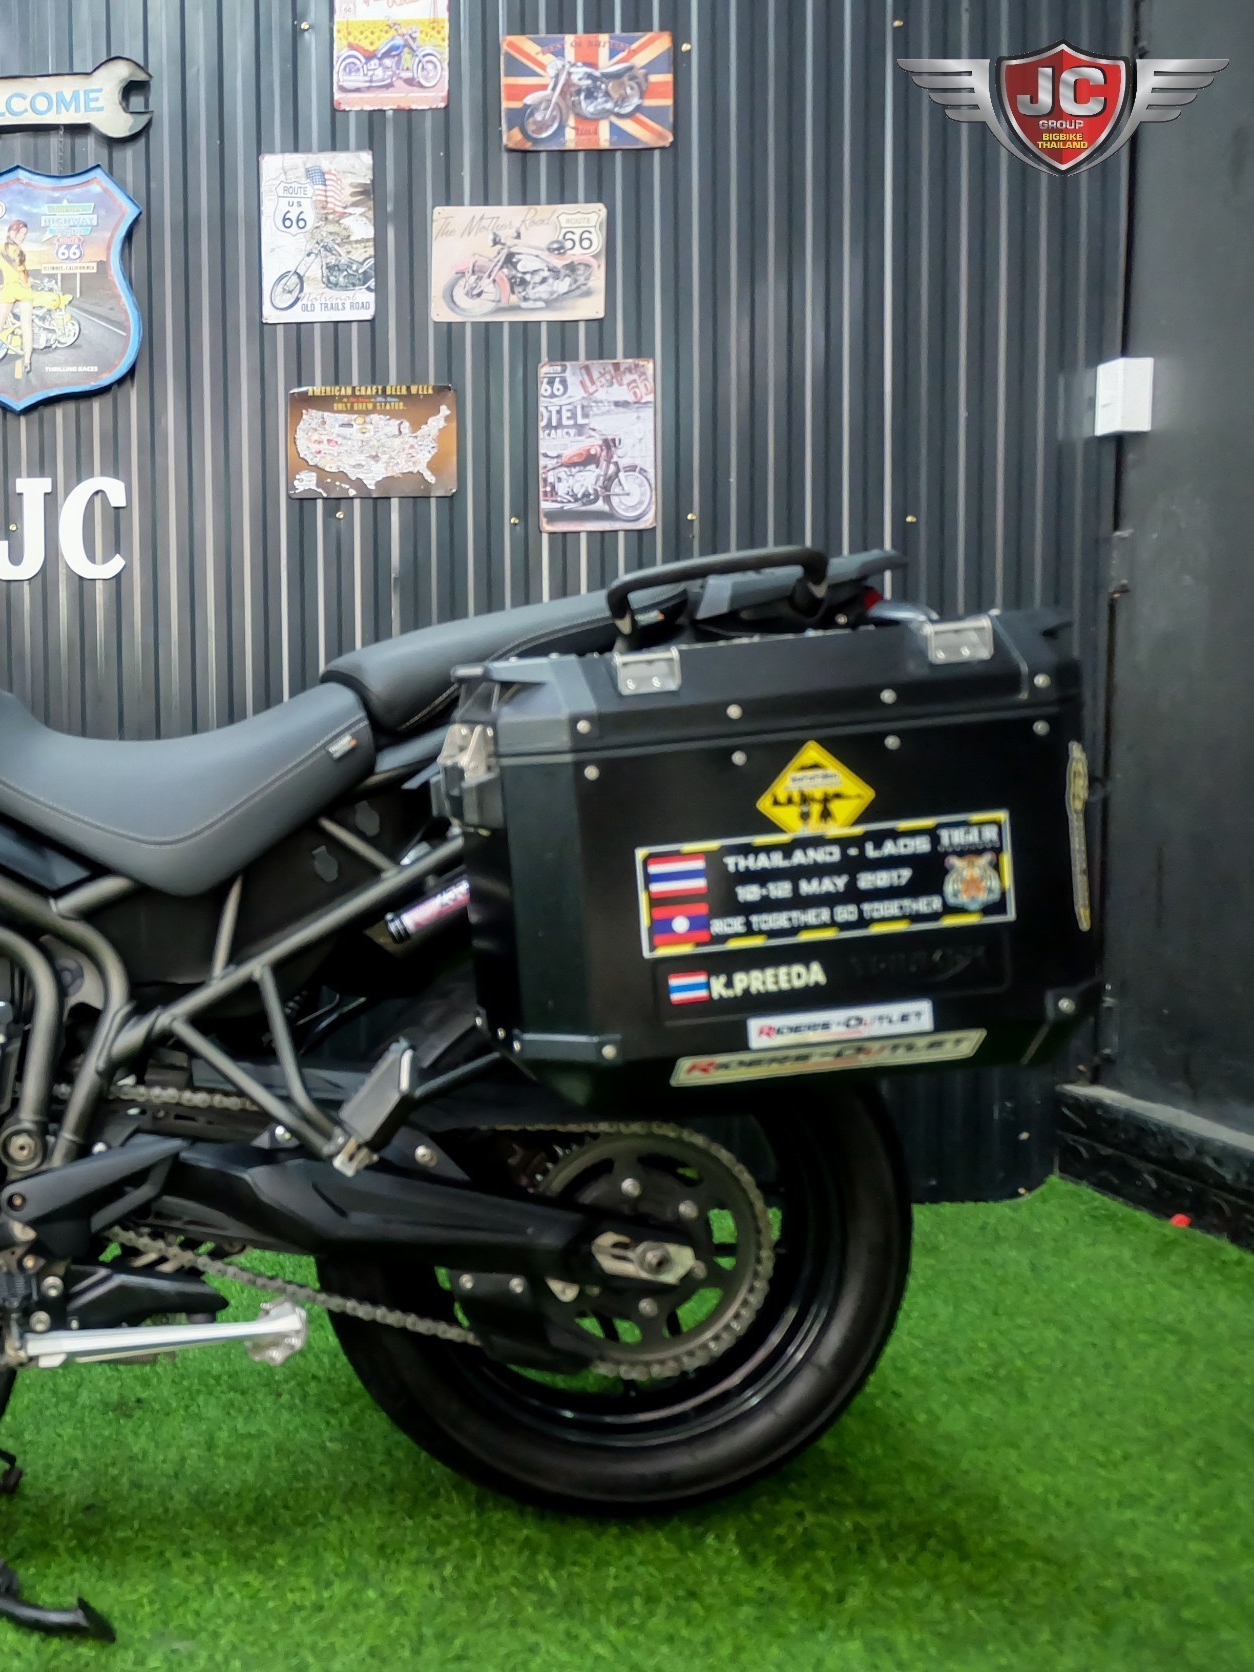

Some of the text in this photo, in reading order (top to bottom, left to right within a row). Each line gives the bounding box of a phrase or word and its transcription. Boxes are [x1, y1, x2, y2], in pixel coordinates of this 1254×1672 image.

[283, 186, 308, 195] ROUTE
[45, 216, 95, 226] HIGHWAY
[282, 210, 307, 229] 66
[434, 216, 457, 240] The
[520, 207, 556, 231] Road
[562, 230, 593, 250] 66
[57, 245, 81, 260] 66
[301, 301, 371, 312] OLD TRAILS ROAD
[308, 386, 352, 396] AMERICAN
[411, 384, 434, 395] WEEK
[540, 377, 564, 397] 66
[723, 844, 841, 873] THAILAND
[865, 835, 931, 859] LAOS
[799, 874, 849, 896] MAY
[709, 960, 827, 1000] K.PREEDA
